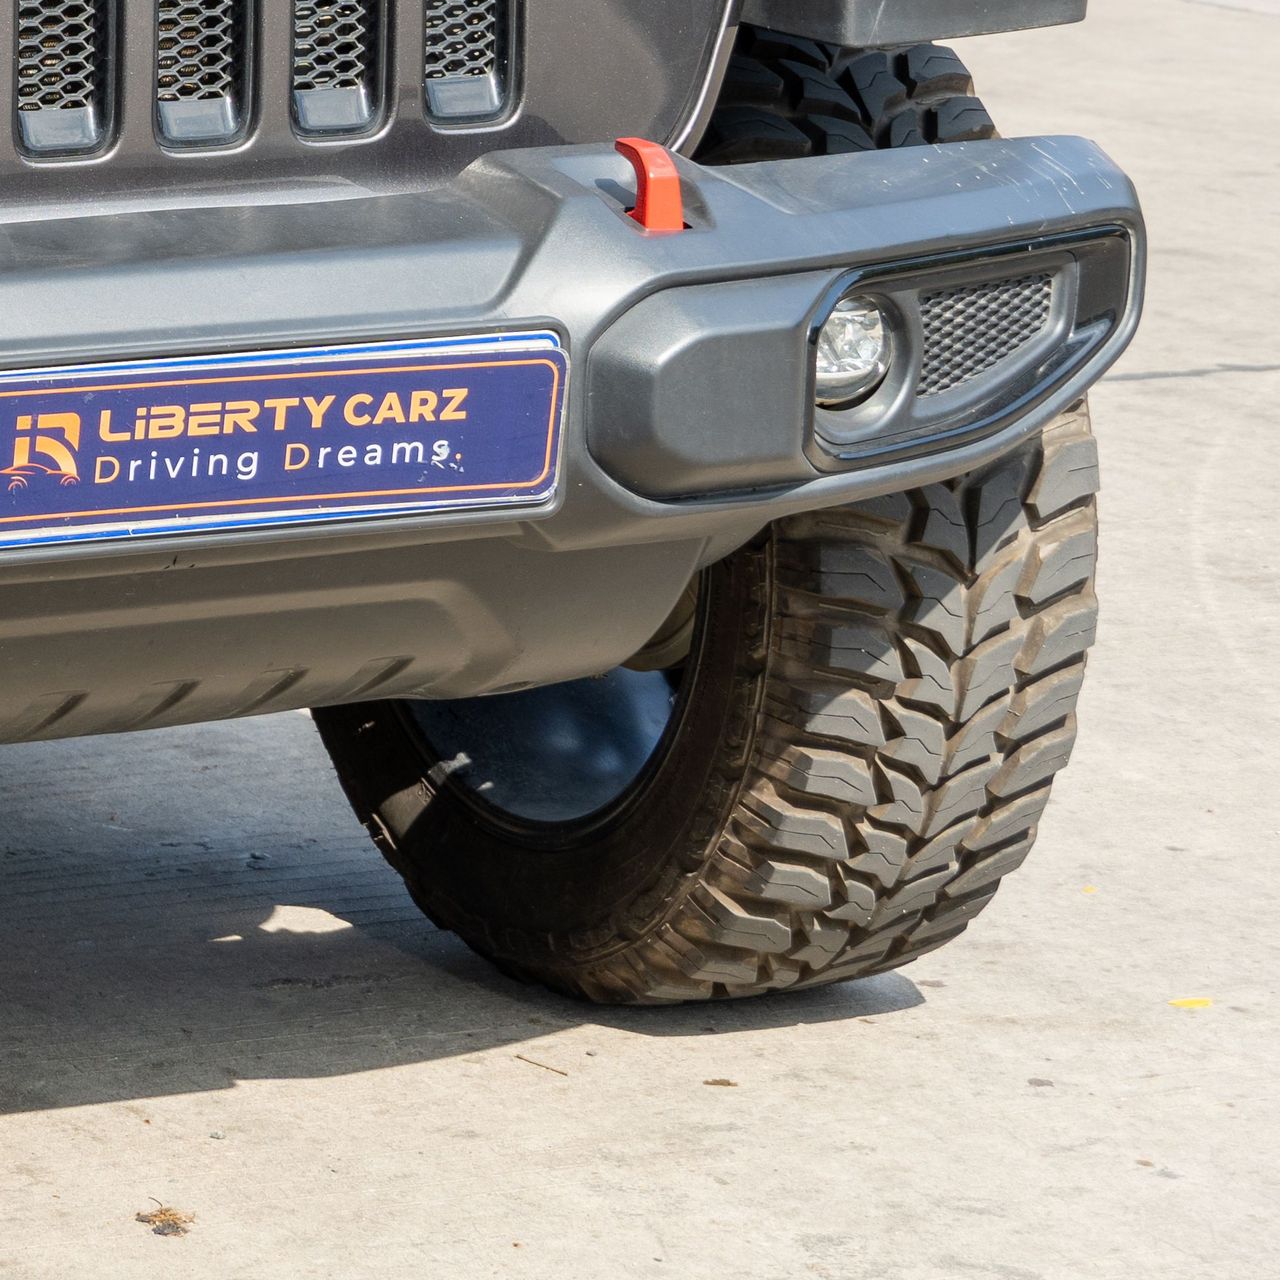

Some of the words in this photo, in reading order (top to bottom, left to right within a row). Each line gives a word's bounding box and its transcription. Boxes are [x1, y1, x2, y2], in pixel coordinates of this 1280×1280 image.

[343, 387, 469, 426] CARZ
[94, 446, 261, 485] Driving
[284, 436, 463, 472] Dreams.
